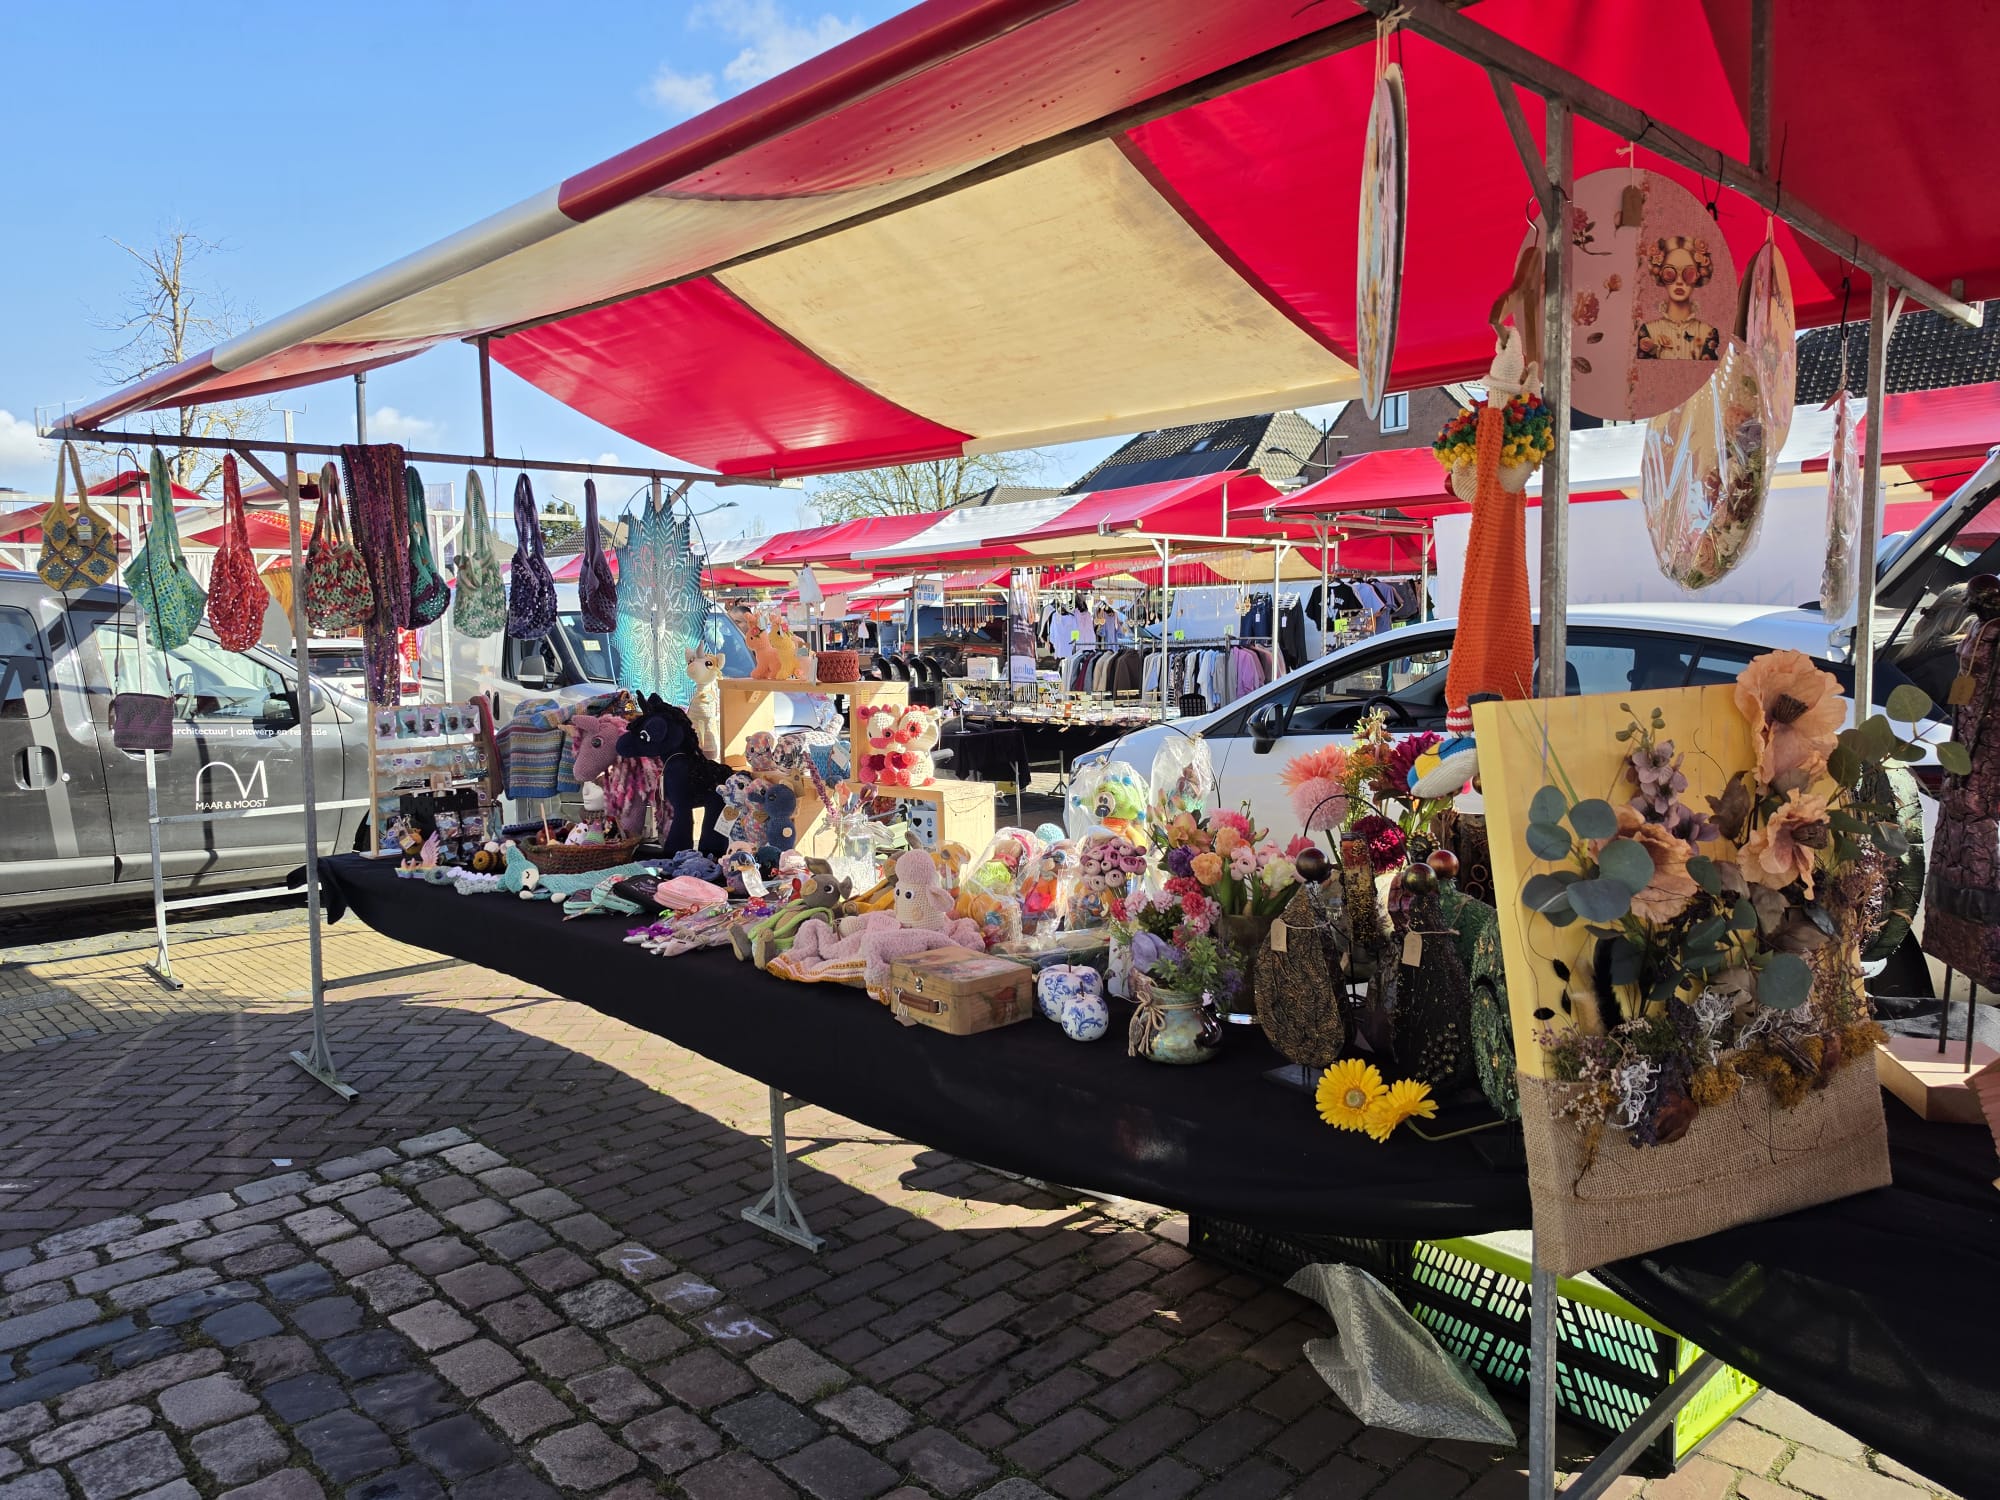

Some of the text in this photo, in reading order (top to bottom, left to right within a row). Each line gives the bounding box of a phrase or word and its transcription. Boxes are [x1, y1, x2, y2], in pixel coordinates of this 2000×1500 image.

[172, 726, 229, 735] architectuur
[236, 727, 274, 737] ontwerp
[195, 799, 268, 810] MAAR & MOOST
